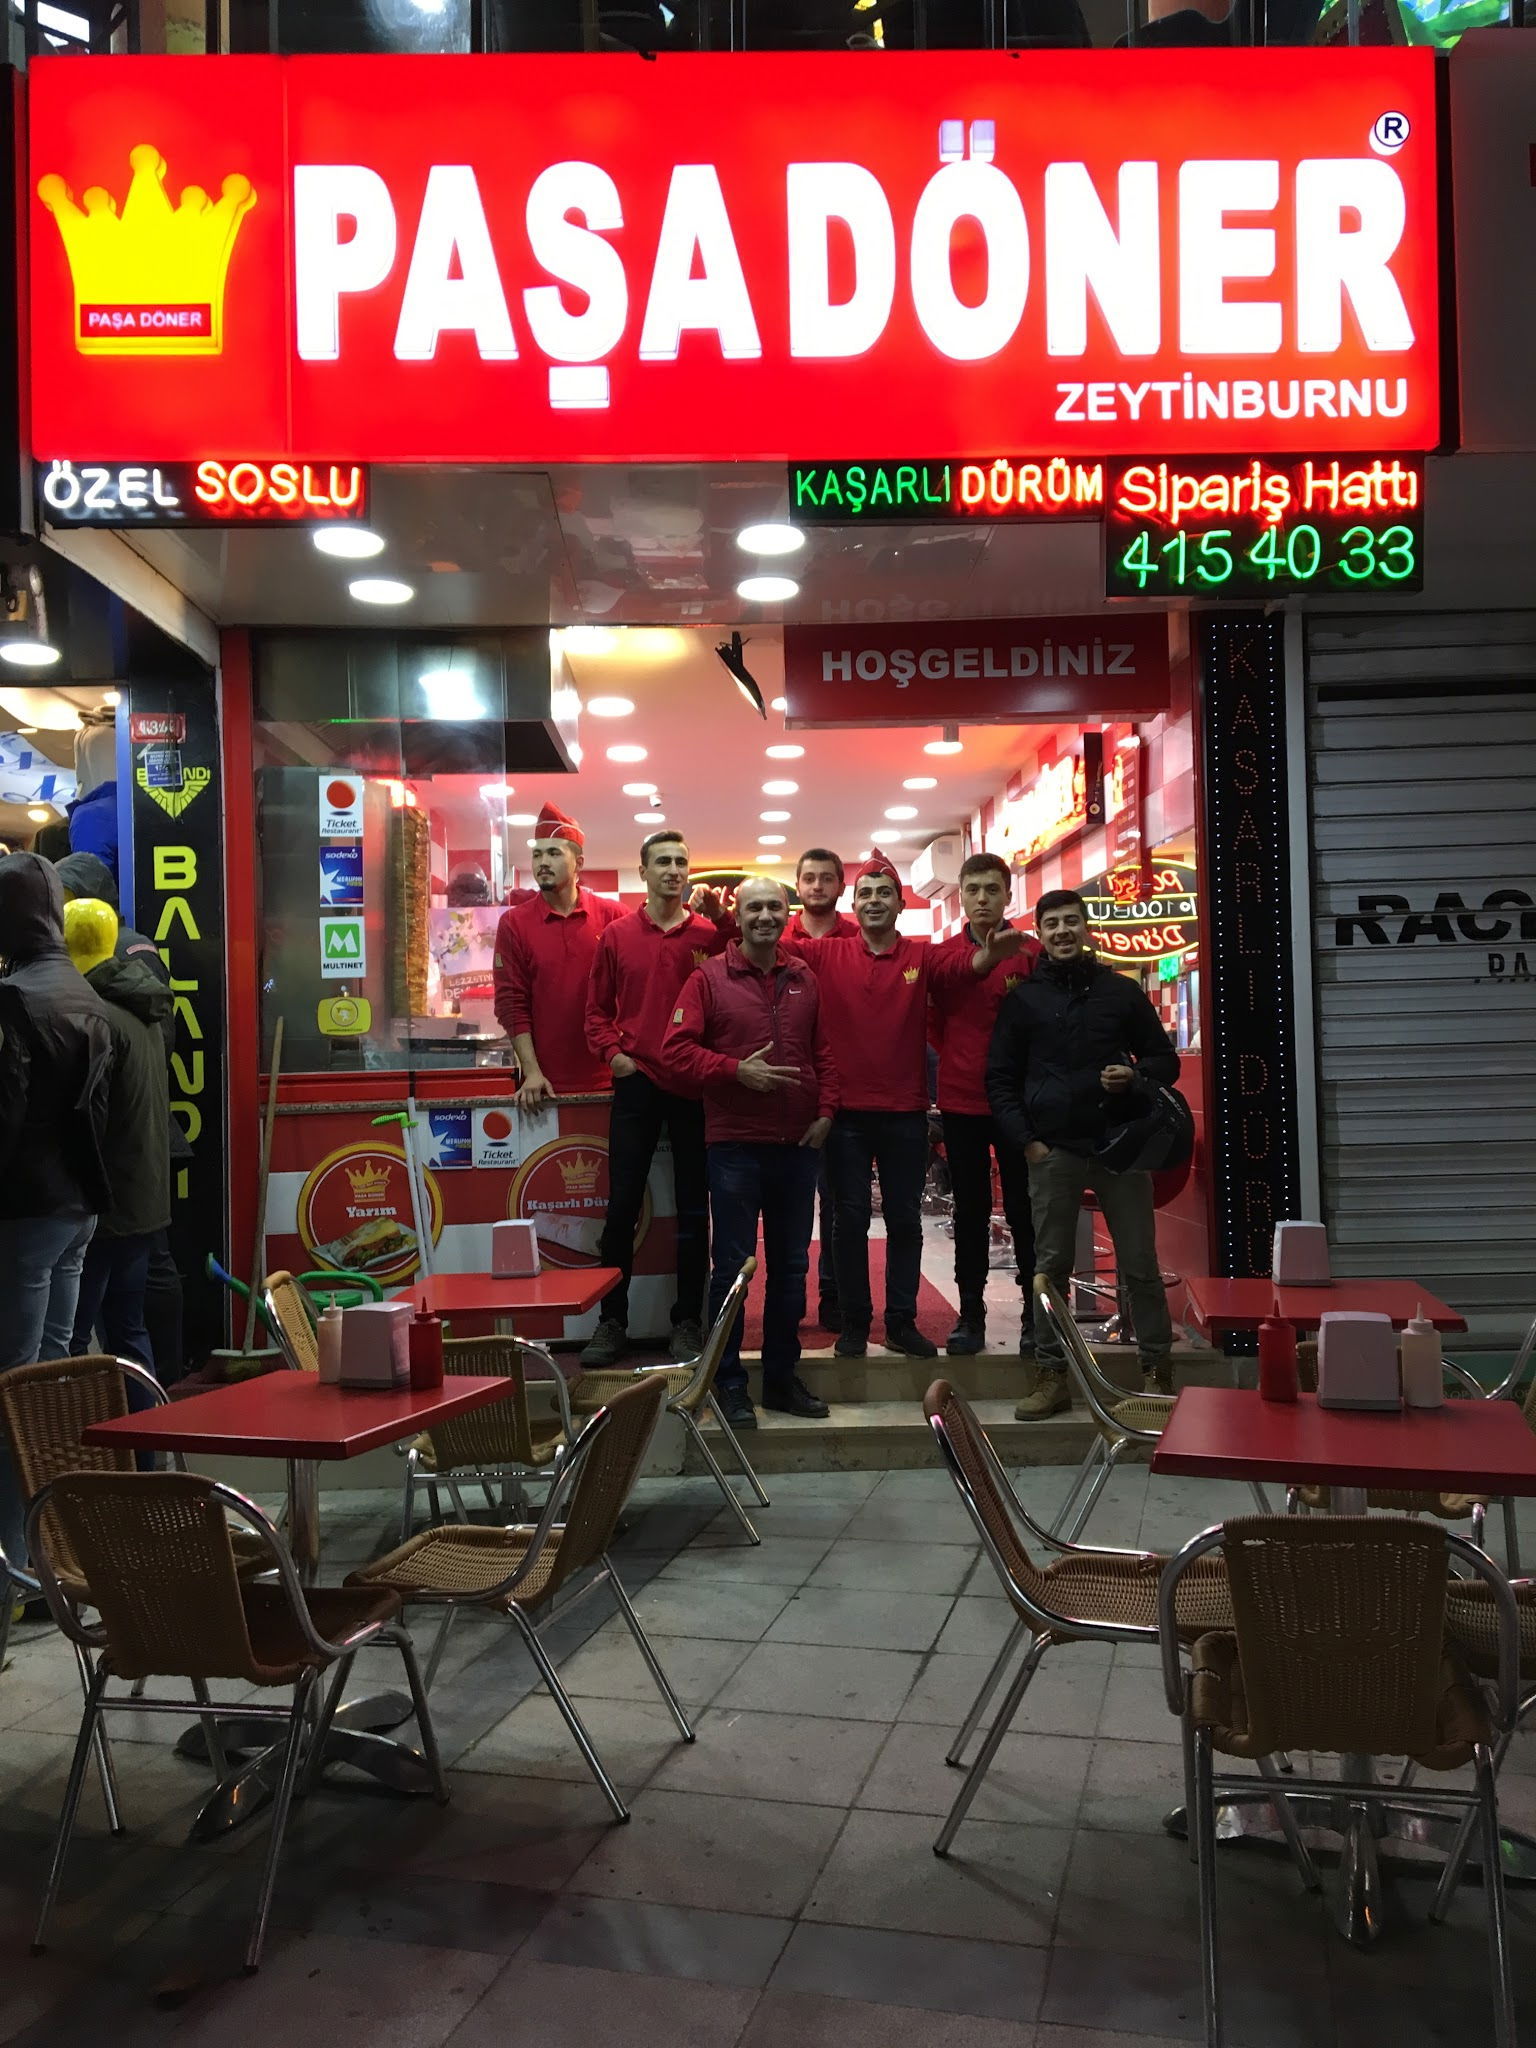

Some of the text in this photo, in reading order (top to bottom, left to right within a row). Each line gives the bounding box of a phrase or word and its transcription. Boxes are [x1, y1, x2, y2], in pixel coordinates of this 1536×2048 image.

[294, 119, 1415, 409] PAŞA DÖNER
[88, 309, 202, 331] PAŞA DÖNER
[1055, 372, 1408, 421] ZEYTİNBURNU
[43, 460, 362, 508] ÖZEL SOSLU
[796, 458, 1103, 512] KAŞARLI DÜRÜM
[1118, 460, 1418, 524] Sipariş Hattı
[1122, 525, 1415, 588] 415 40 33
[822, 638, 1136, 687] HOŞGELDİNİZ
[326, 819, 357, 828] Ticket
[434, 1110, 467, 1121] sodexo
[482, 1150, 513, 1159] Ticket
[345, 1206, 397, 1218] Yarım
[527, 1198, 581, 1211] Kaşarlı
